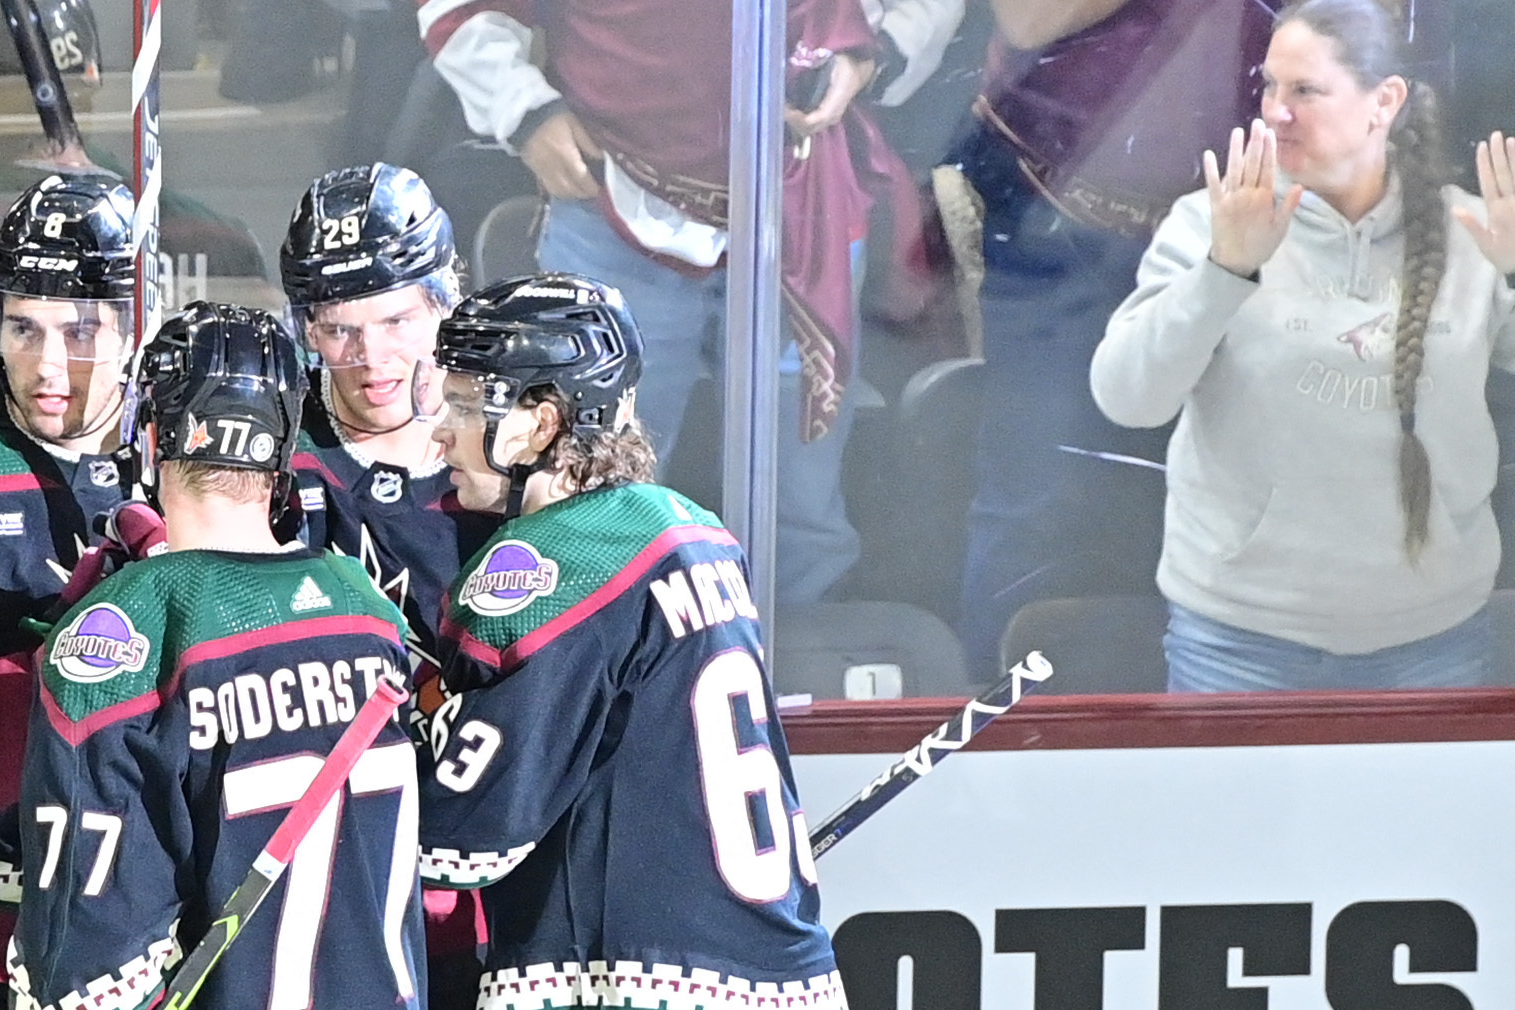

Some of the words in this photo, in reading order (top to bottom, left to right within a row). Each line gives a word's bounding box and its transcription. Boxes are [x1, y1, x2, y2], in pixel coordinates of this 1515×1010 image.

[42, 212, 67, 238] 8
[321, 215, 361, 250] 29
[18, 255, 79, 272] CCM
[217, 419, 252, 456] 77
[36, 806, 123, 896] 77
